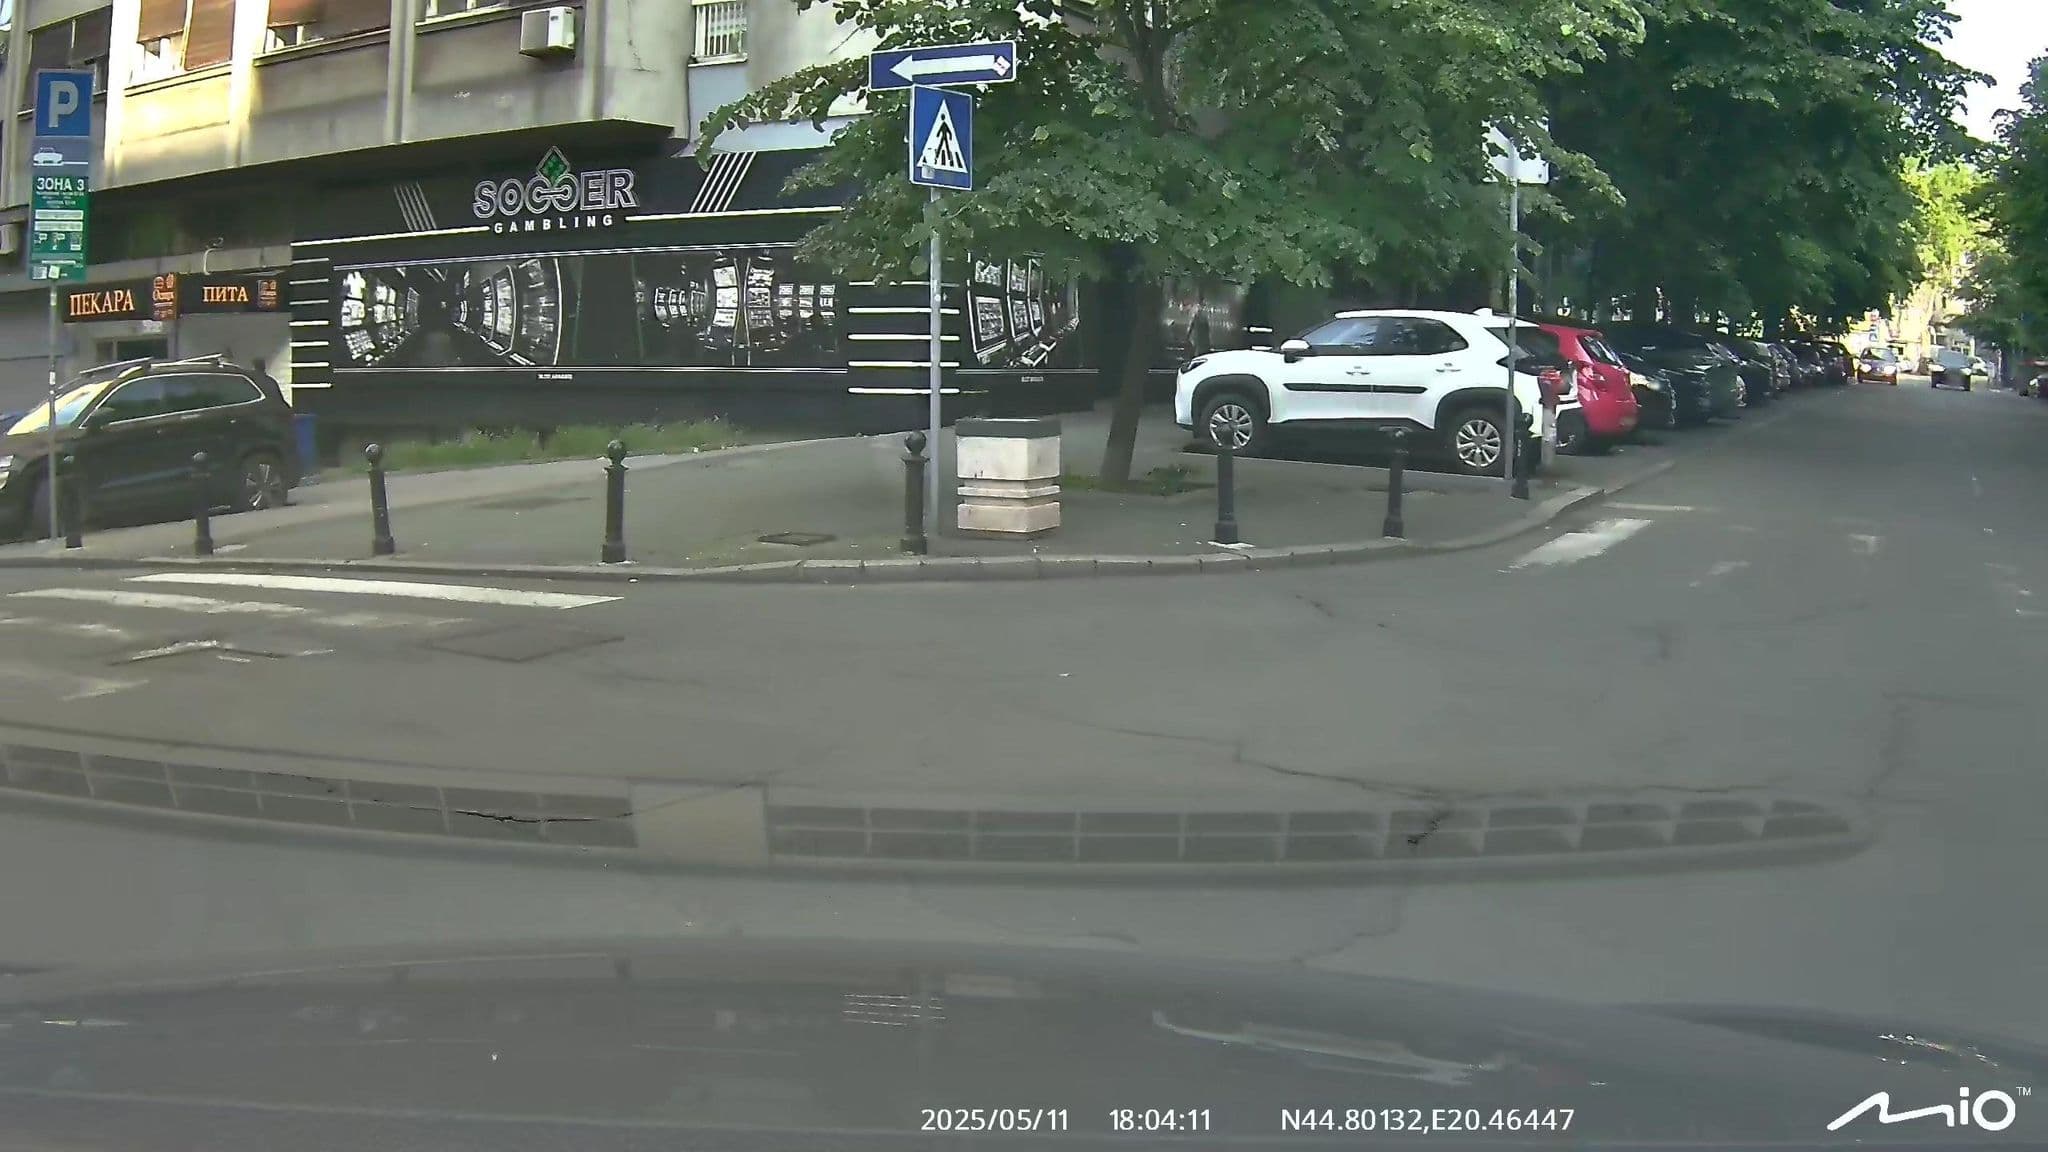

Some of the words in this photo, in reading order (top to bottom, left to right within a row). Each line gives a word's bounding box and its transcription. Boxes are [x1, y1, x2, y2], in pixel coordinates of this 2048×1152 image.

[48, 81, 79, 128] P
[36, 177, 72, 191] ЗОНА
[77, 179, 85, 191] 3
[472, 168, 639, 219] SOCCER
[494, 214, 613, 234] GAMBLING
[69, 289, 135, 316] ПЕКАРА
[202, 286, 249, 302] ПИТА
